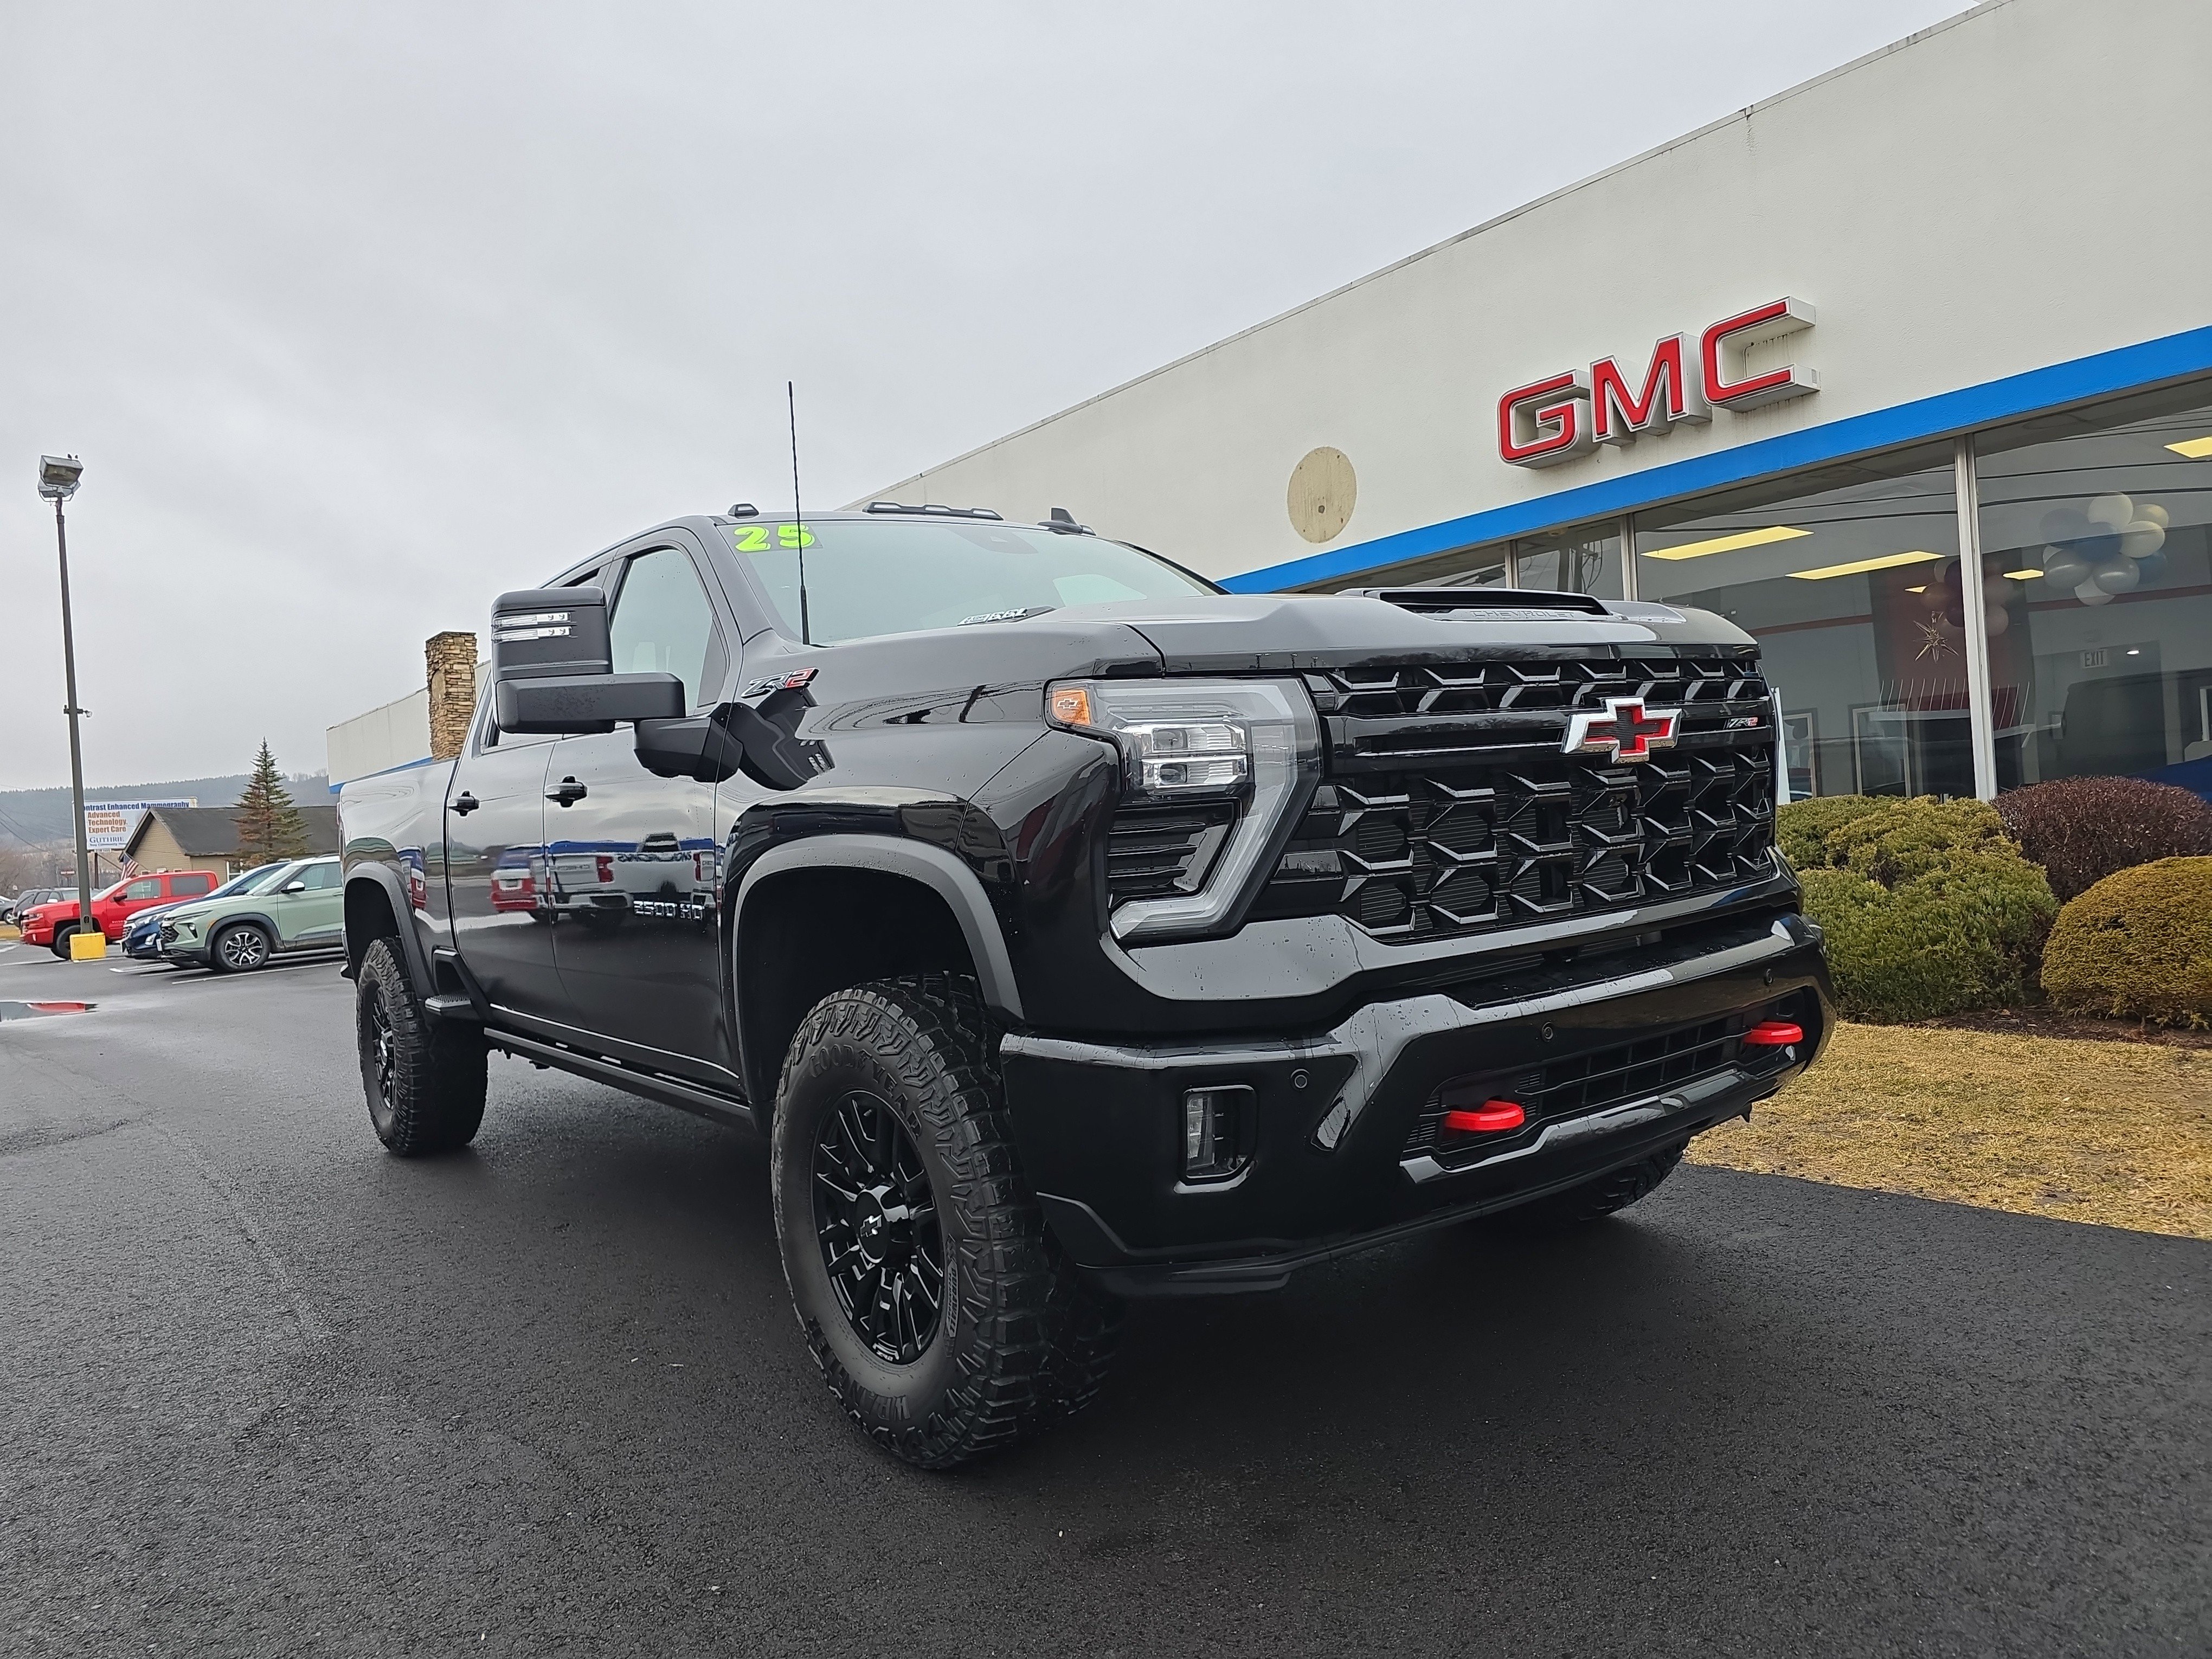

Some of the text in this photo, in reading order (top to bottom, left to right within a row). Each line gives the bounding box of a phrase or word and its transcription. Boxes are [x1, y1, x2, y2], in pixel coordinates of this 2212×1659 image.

[1496, 295, 1820, 470] GMC
[733, 524, 815, 552] 25
[1469, 610, 1574, 618] CHEVROLET
[2084, 650, 2104, 667] EXIT
[740, 666, 820, 699] ZR2
[1727, 717, 1758, 728] ZR2
[633, 901, 705, 921] 2500 HD
[809, 1044, 922, 1137] GOODYEAR
[807, 1316, 911, 1421] WRANGLER
